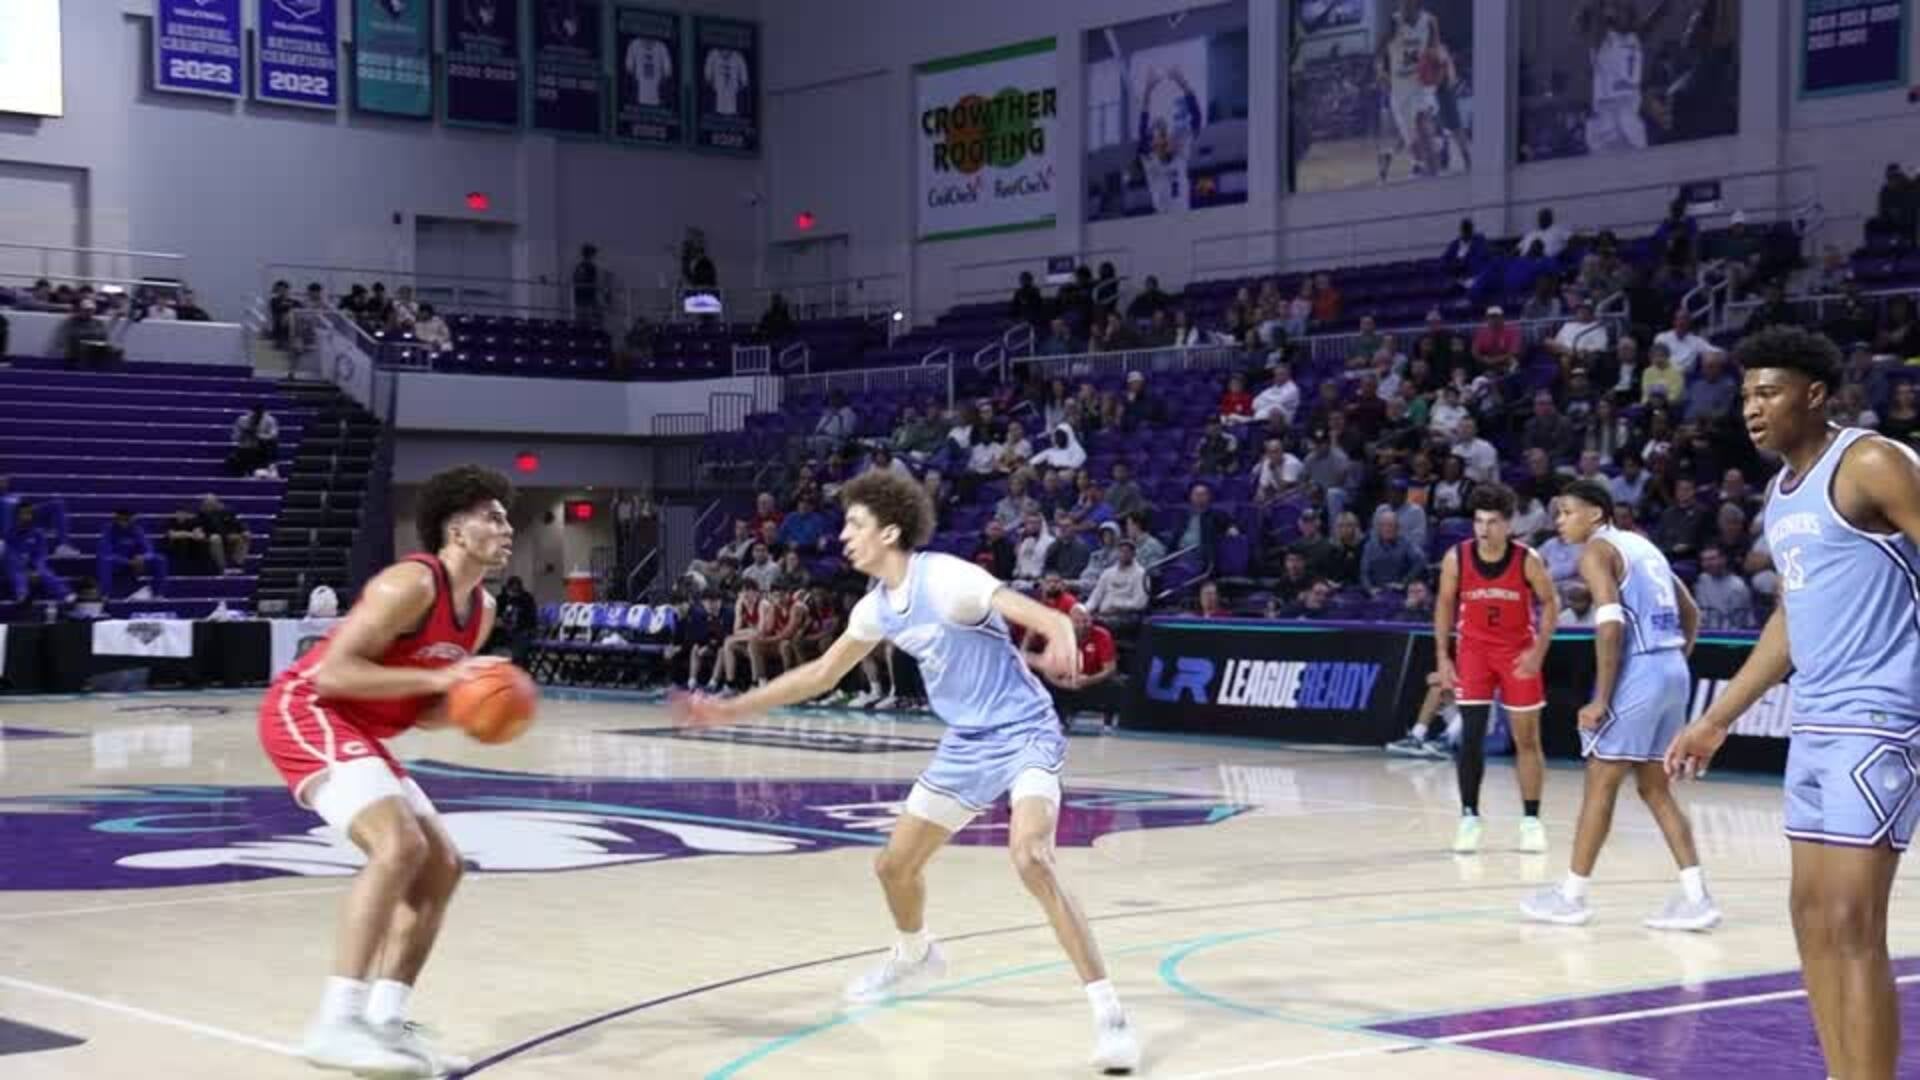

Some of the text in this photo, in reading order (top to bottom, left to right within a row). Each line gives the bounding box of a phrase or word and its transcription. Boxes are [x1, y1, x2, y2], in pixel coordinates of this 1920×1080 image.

[170, 58, 233, 84] 2023
[269, 71, 329, 96] 2022
[921, 87, 1057, 138] CROWTHER
[933, 127, 1045, 173] ROOFING
[1487, 605, 1501, 627] 2
